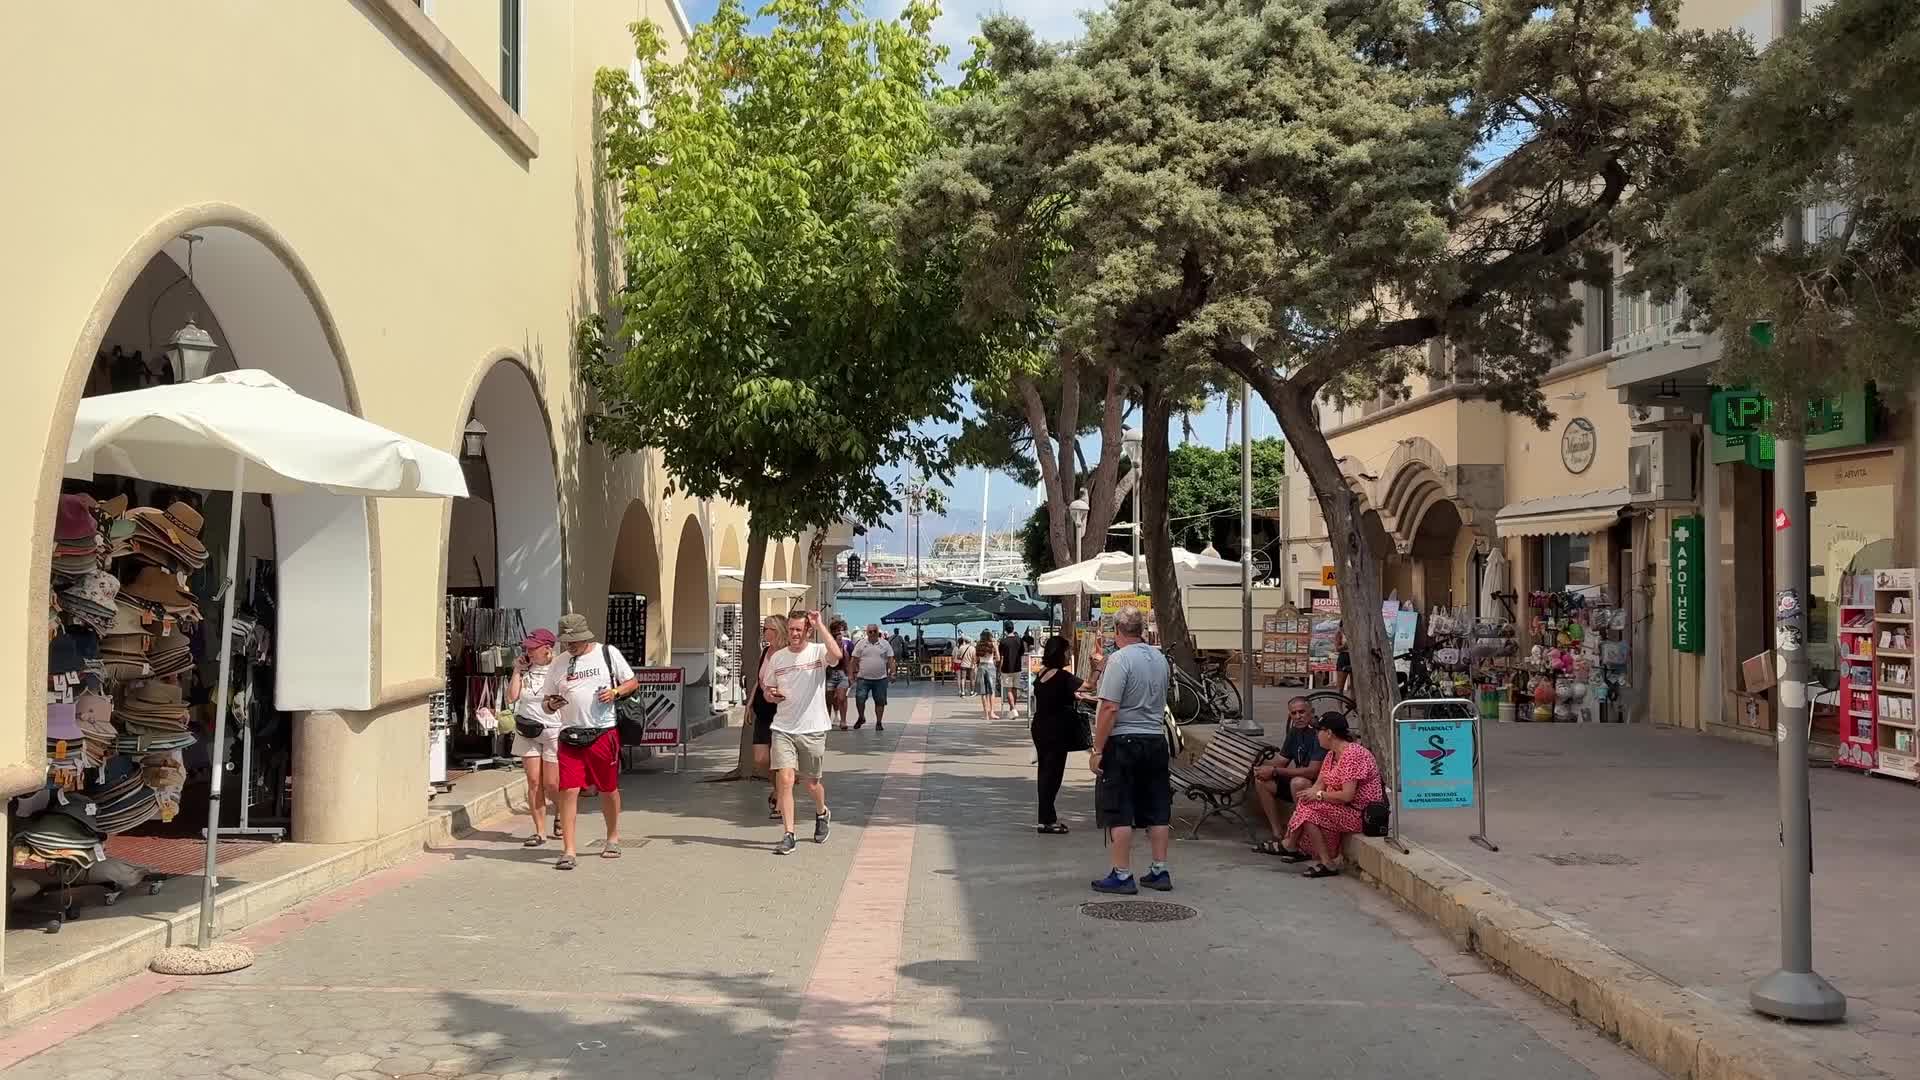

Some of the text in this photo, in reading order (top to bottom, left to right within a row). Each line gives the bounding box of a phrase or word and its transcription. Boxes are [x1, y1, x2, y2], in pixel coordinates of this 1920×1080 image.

[1677, 546, 1688, 645] APOTHEKE
[579, 667, 601, 679] DIESEL
[636, 672, 677, 681] OBACCO SHOP
